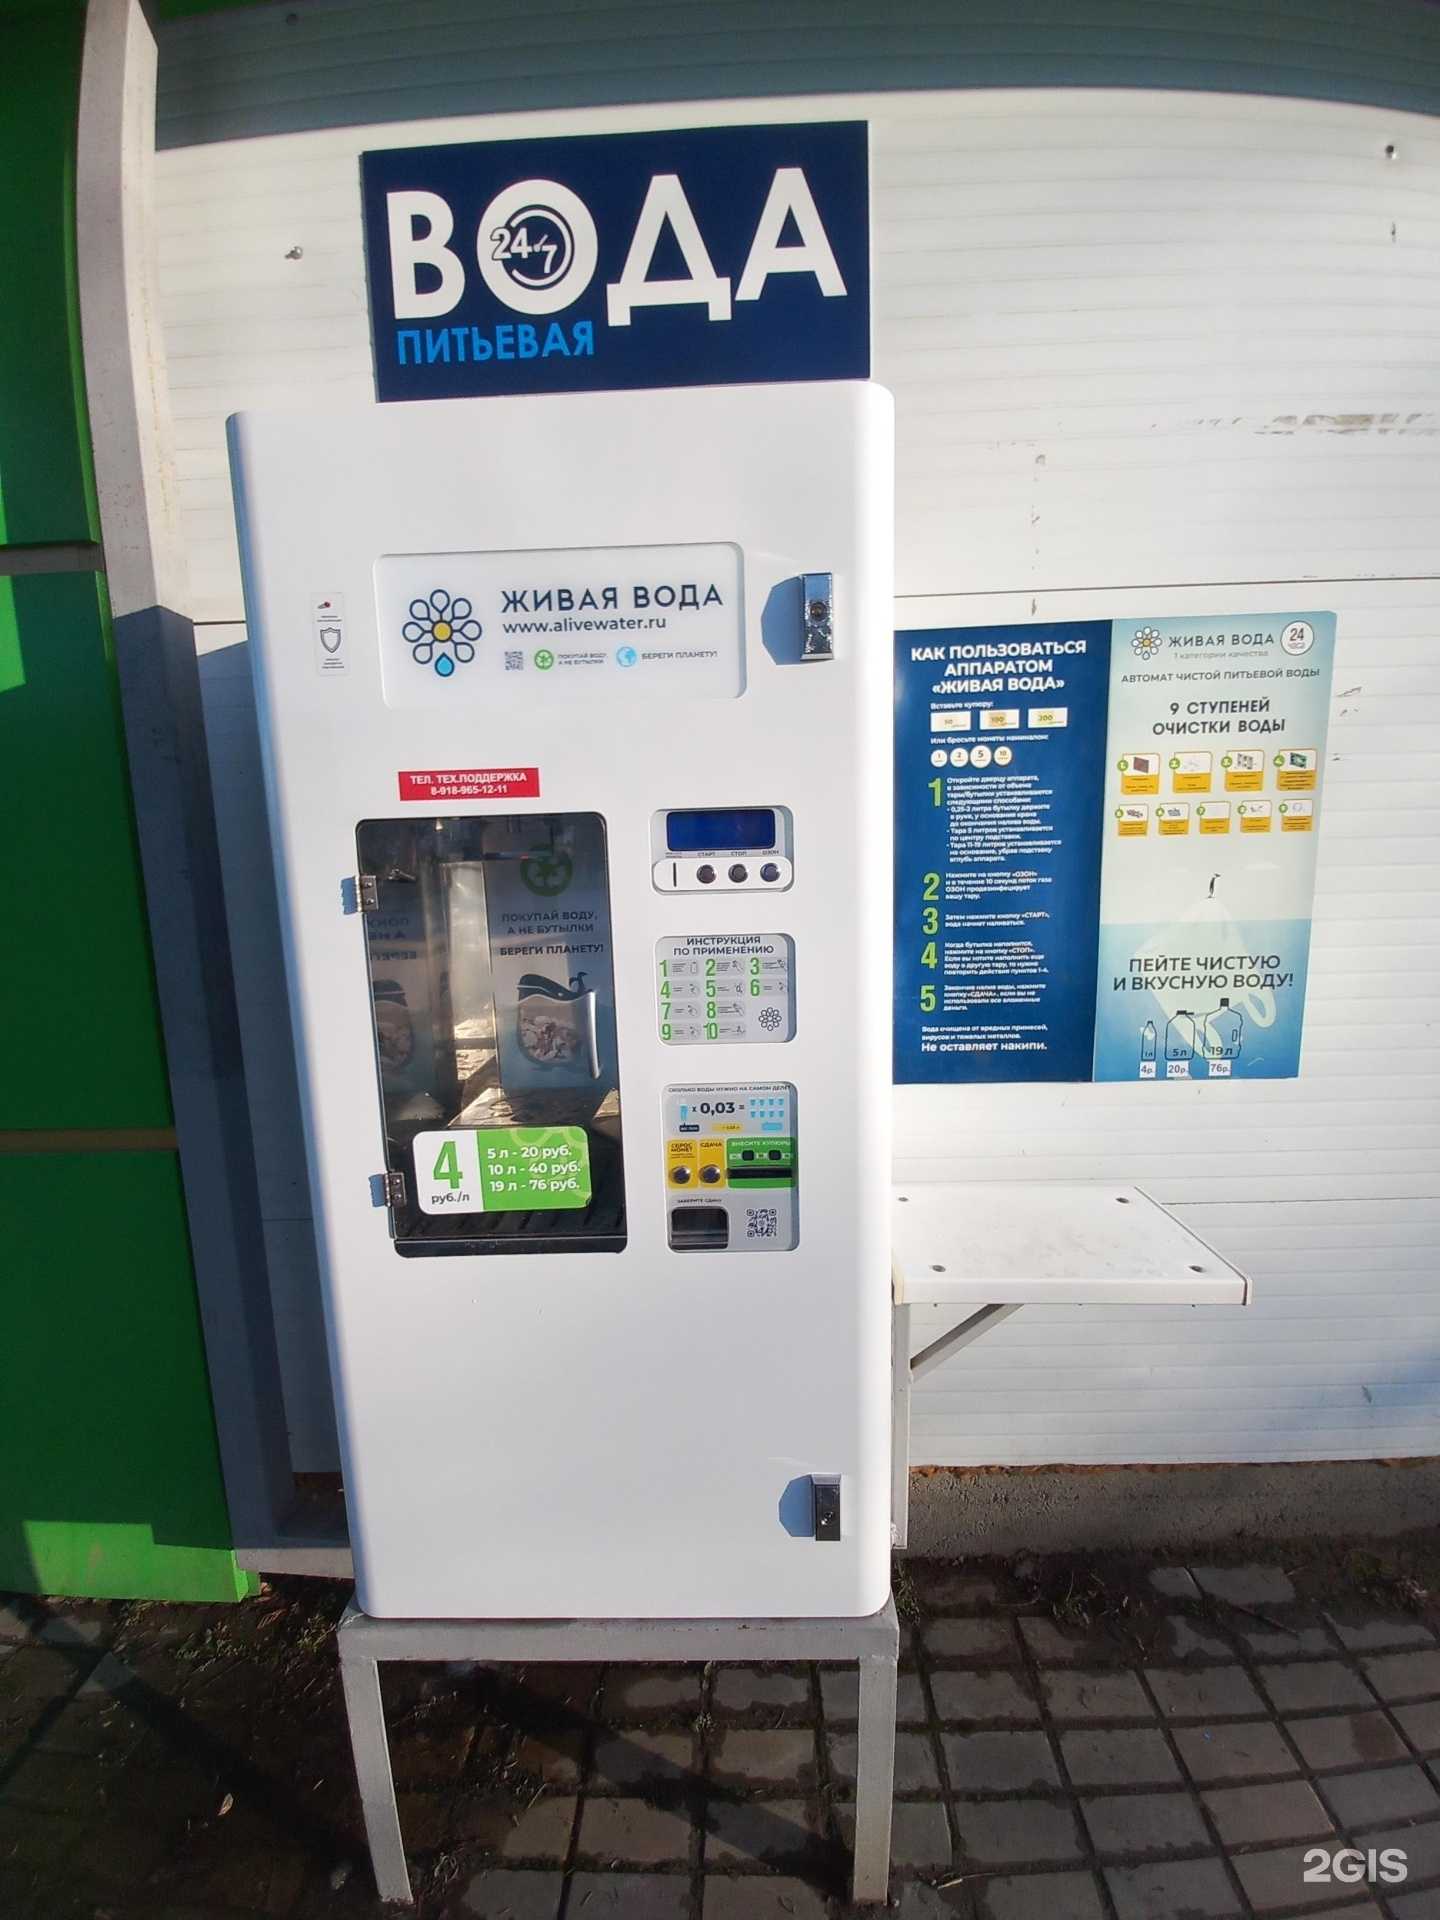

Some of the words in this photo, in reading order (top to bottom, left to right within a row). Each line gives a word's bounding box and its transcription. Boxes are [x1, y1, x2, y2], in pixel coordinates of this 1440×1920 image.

[386, 167, 848, 326] ВОДА
[397, 320, 595, 365] ПИТЬЕВАЯ
[501, 585, 619, 613] ЖИВАЯ
[633, 583, 724, 611] ВОДА
[502, 615, 667, 634] www.alivewater.ru
[1168, 634, 1225, 648] ЖИВАЯ
[1231, 633, 1275, 647] ВОДА
[1289, 627, 1305, 642] 24
[641, 652, 674, 660] БЕРЕГИ
[675, 651, 718, 659] ПЛАНЕТУ!
[911, 647, 945, 661] КАК
[949, 640, 1087, 659] ПОЛЬЗОВАТЬСЯ
[944, 659, 1053, 677] АППАРАТОМ
[1121, 672, 1173, 683] АВТОМАТ
[1176, 670, 1221, 681] ЧИСТОЙ
[1223, 667, 1283, 680] ПИТЬЕВОЙ
[1286, 668, 1320, 678] ВОДЫ
[932, 679, 1003, 694] «ЖИВАЯ
[1007, 676, 1065, 692] ВОДА»
[1169, 702, 1180, 715] 9
[1186, 696, 1270, 715] СТУПЕНЕЙ
[1152, 720, 1230, 736] ОЧИСТКИ
[1237, 718, 1286, 734] ВОДЫ
[410, 774, 434, 785] ТЕЛ.
[430, 784, 508, 797] 8-918-965-12-11
[928, 777, 942, 807] 1
[923, 872, 941, 901] 2
[502, 910, 559, 922] ПОКУПАЙ
[922, 907, 938, 934] 3
[507, 926, 516, 934] А
[519, 926, 534, 934] НЕ
[537, 923, 594, 934] БУТЫЛКИ
[500, 946, 543, 956] БЕРЕГИ
[546, 944, 604, 954] ПЛАНЕТУ!
[686, 936, 761, 946] ИНСТРУКЦИЯ
[673, 947, 690, 956] ПО
[693, 945, 774, 955] ПРИМЕНЕНИЮ
[920, 942, 938, 969] 4
[659, 959, 668, 977] 1
[706, 958, 716, 977] 2
[750, 957, 760, 975] 3
[1129, 954, 1191, 972] ПЕЙТЕ
[1196, 955, 1281, 970] ЧИСТУЮ
[660, 980, 671, 998] 4
[706, 980, 716, 997] 5
[750, 979, 760, 997] 6
[1113, 977, 1126, 991] И
[1132, 974, 1228, 990] ВКУСНУЮ
[1233, 973, 1294, 990] ВОДУ!
[920, 985, 936, 1012] 5
[661, 1002, 672, 1020] 7
[706, 1001, 716, 1019] 8
[661, 1023, 672, 1040] 9
[703, 1022, 718, 1040] 10
[921, 1042, 938, 1052] Не
[939, 1042, 999, 1051] оставляет
[1000, 1041, 1048, 1051] накипи.
[700, 1101, 735, 1116] 0,03
[487, 1148, 497, 1159] 5
[499, 1150, 508, 1158] л
[521, 1147, 539, 1158] 20
[542, 1145, 572, 1159] руб.
[433, 1141, 463, 1189] 4
[487, 1164, 504, 1175] 10
[506, 1166, 517, 1175] л
[528, 1162, 548, 1173] 40
[551, 1161, 581, 1175] руб.
[489, 1181, 504, 1192] 19
[507, 1182, 517, 1191] л
[529, 1179, 548, 1190] 76
[550, 1177, 580, 1192] руб.
[431, 1192, 470, 1205] руб./л
